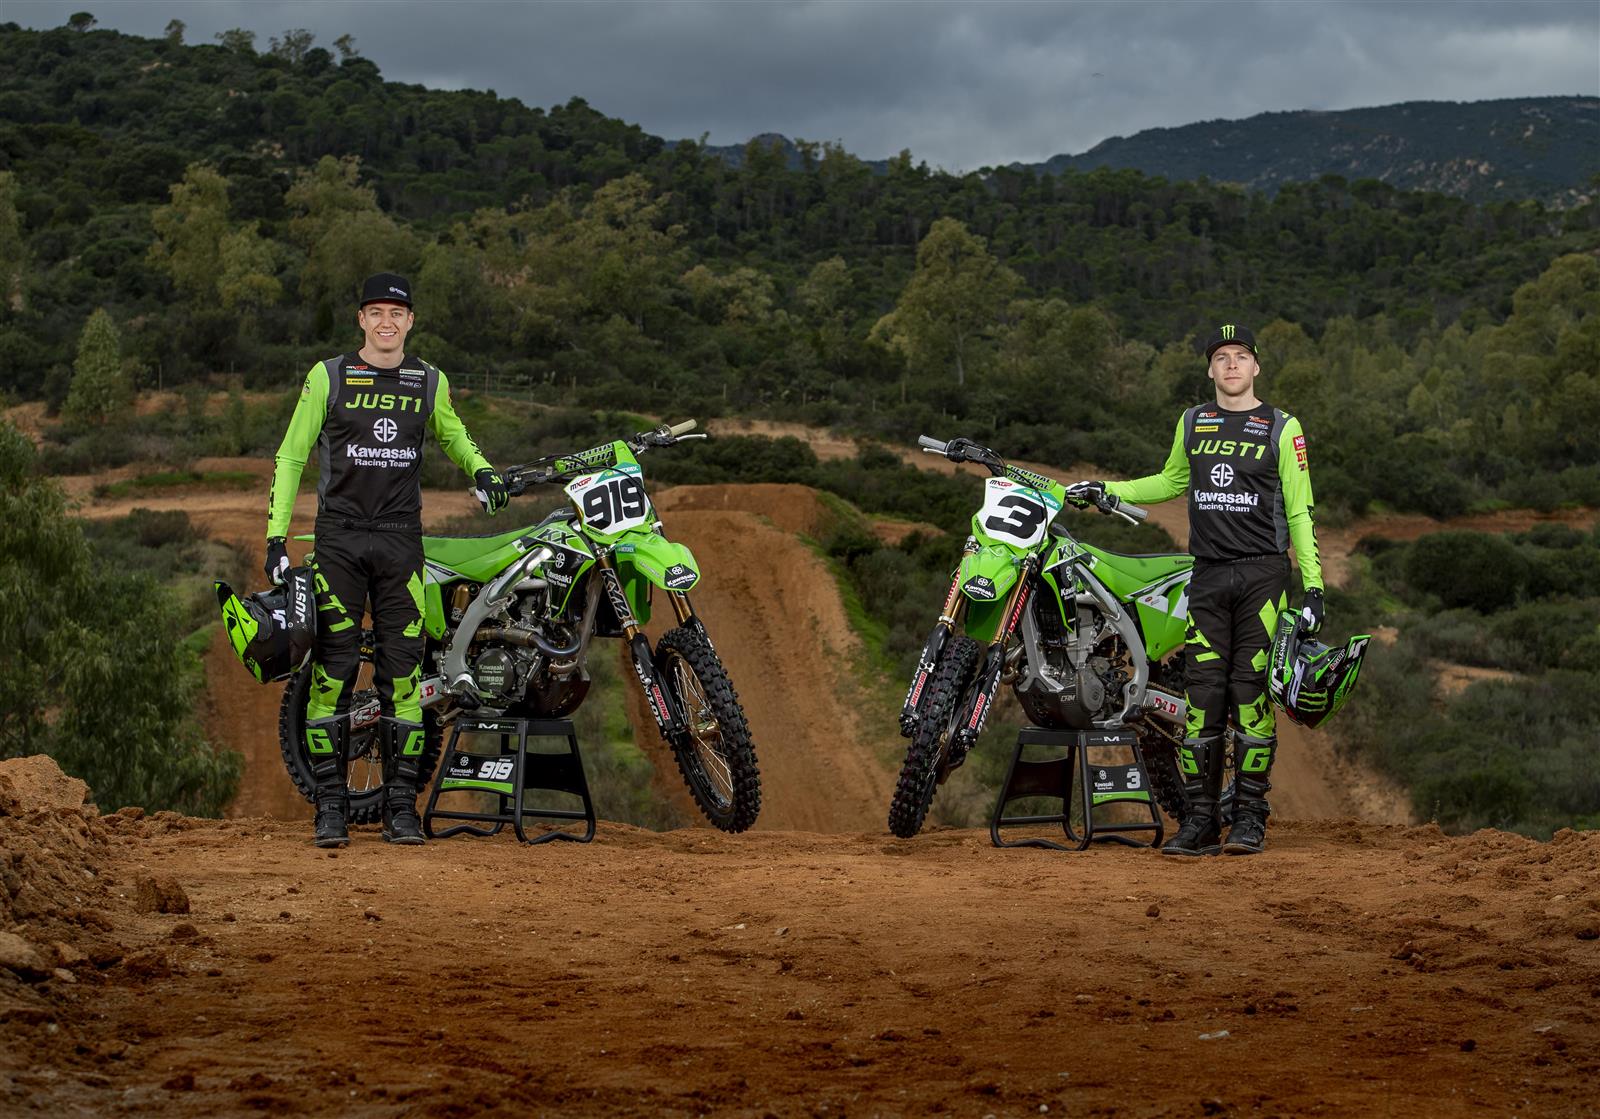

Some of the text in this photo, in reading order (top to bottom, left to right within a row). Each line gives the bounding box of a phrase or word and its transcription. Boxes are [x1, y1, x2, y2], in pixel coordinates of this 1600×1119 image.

[345, 393, 422, 413] JUST1
[346, 444, 417, 460] Kawasaki
[1191, 440, 1266, 460] JUST1
[354, 458, 411, 468] Racing Team
[583, 476, 646, 530] 919
[1194, 489, 1259, 506] Kawasaki
[1198, 502, 1250, 512] Racing Team
[985, 495, 1046, 539] 3
[477, 761, 514, 780] 919
[1126, 771, 1141, 789] 3
